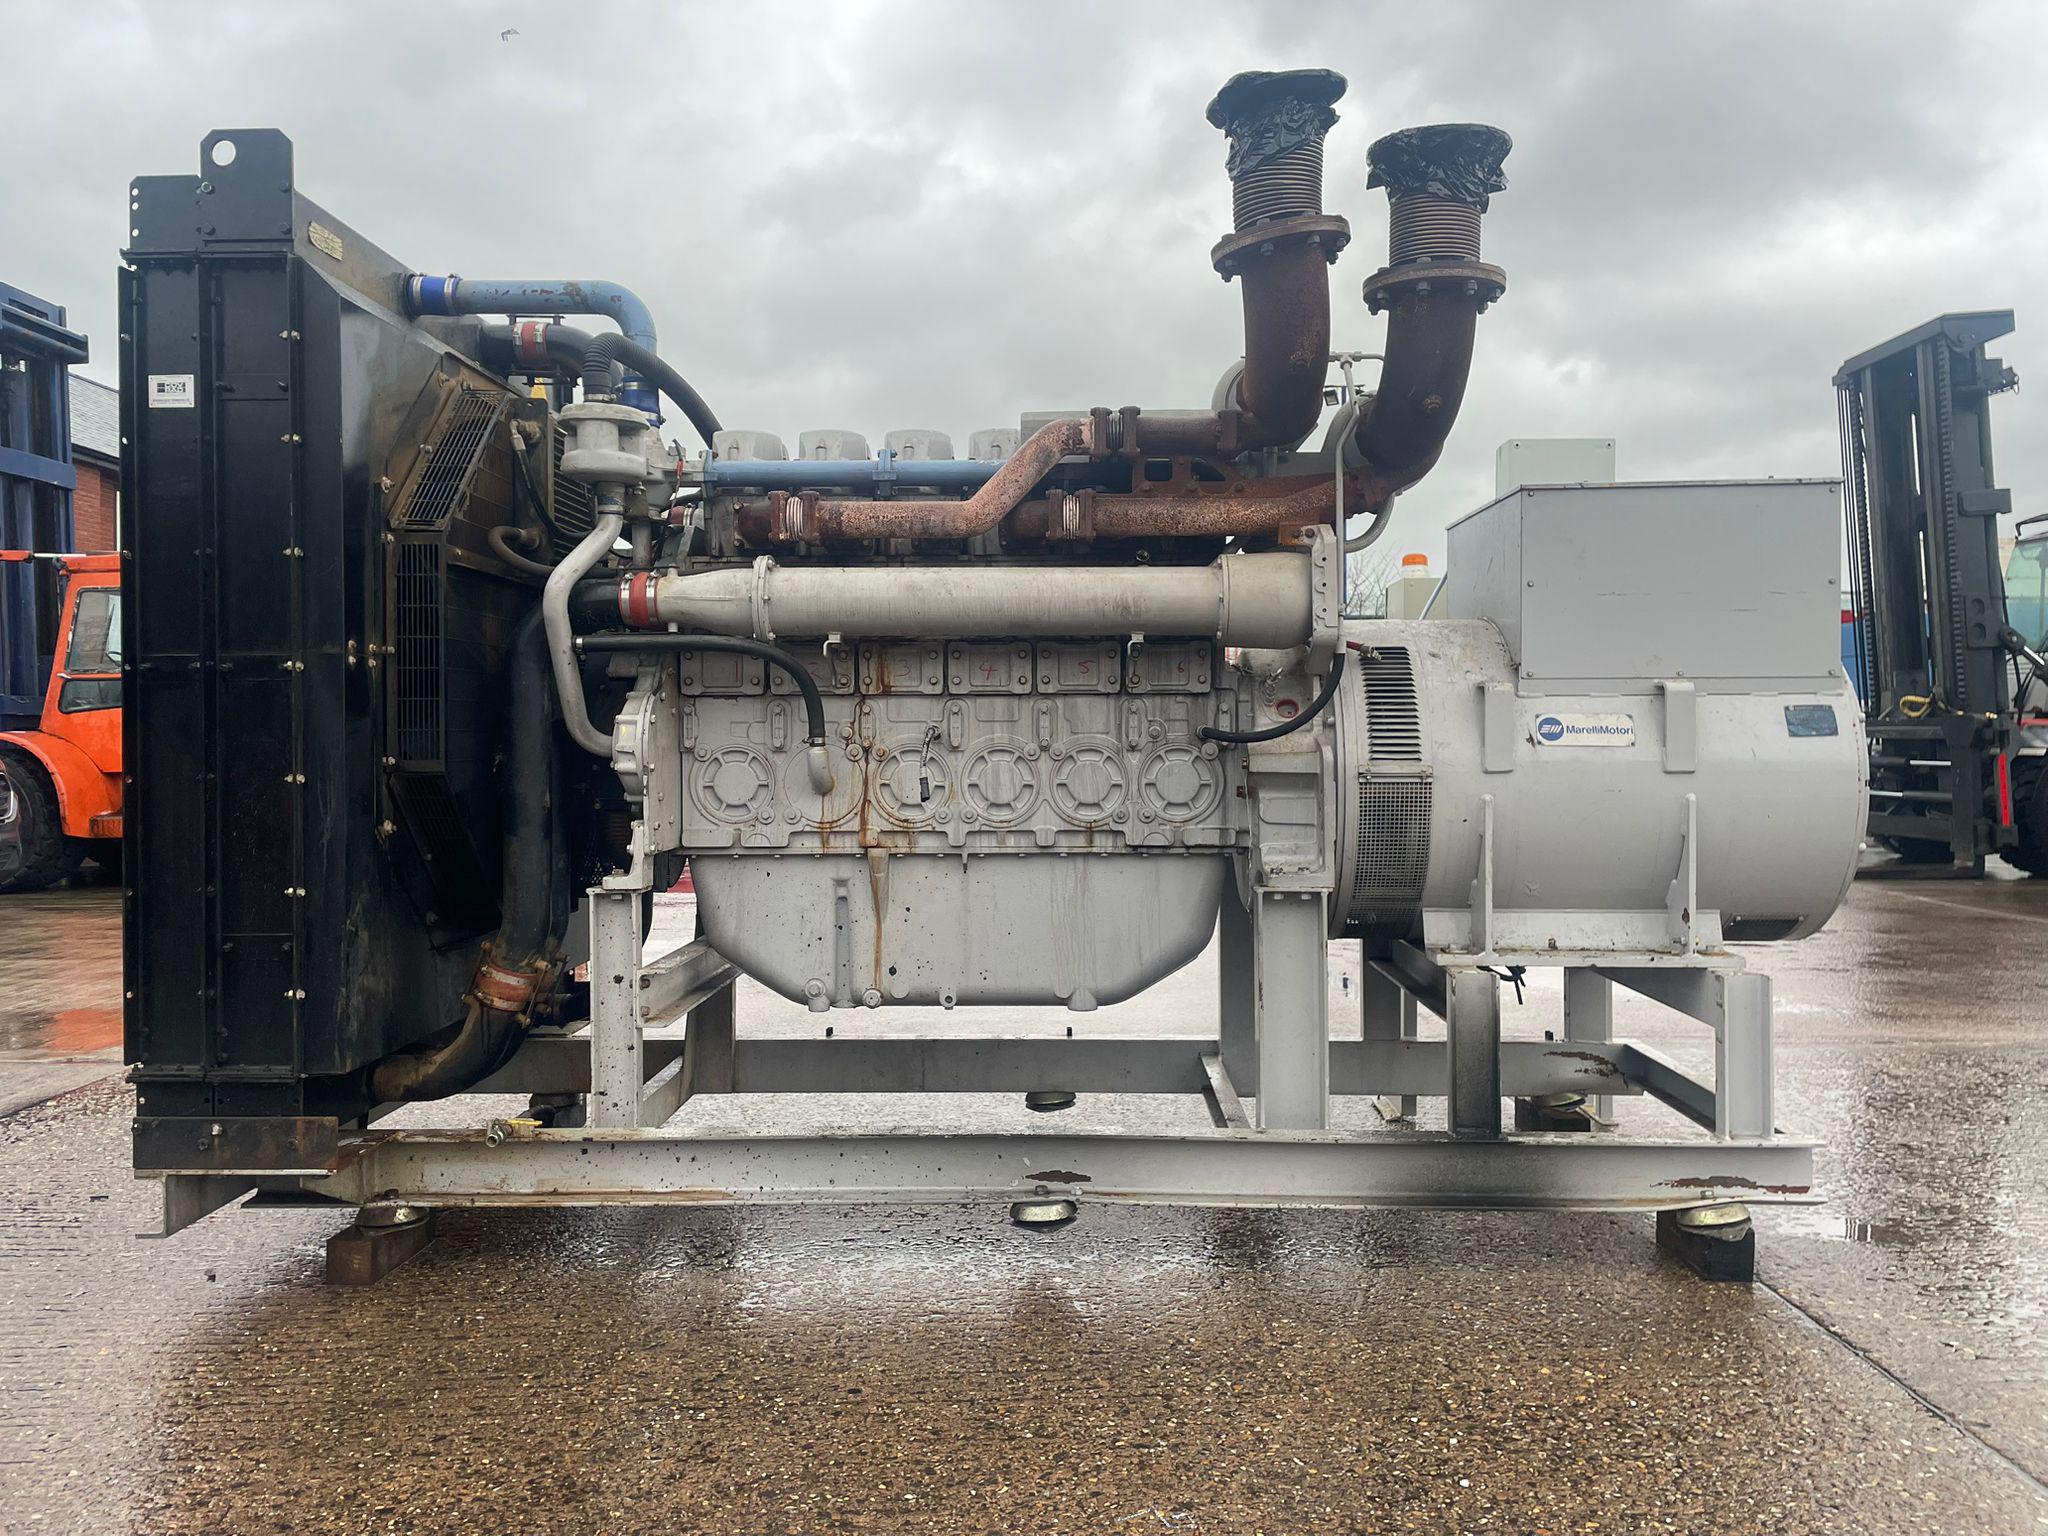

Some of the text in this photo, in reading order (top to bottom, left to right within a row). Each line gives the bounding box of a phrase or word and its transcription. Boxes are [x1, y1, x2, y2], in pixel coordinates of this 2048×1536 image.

[896, 659, 911, 678] 3
[979, 658, 998, 681] 4
[1078, 659, 1097, 675] 5
[1176, 661, 1185, 674] 6
[1566, 725, 1634, 736] MarelliMotori
